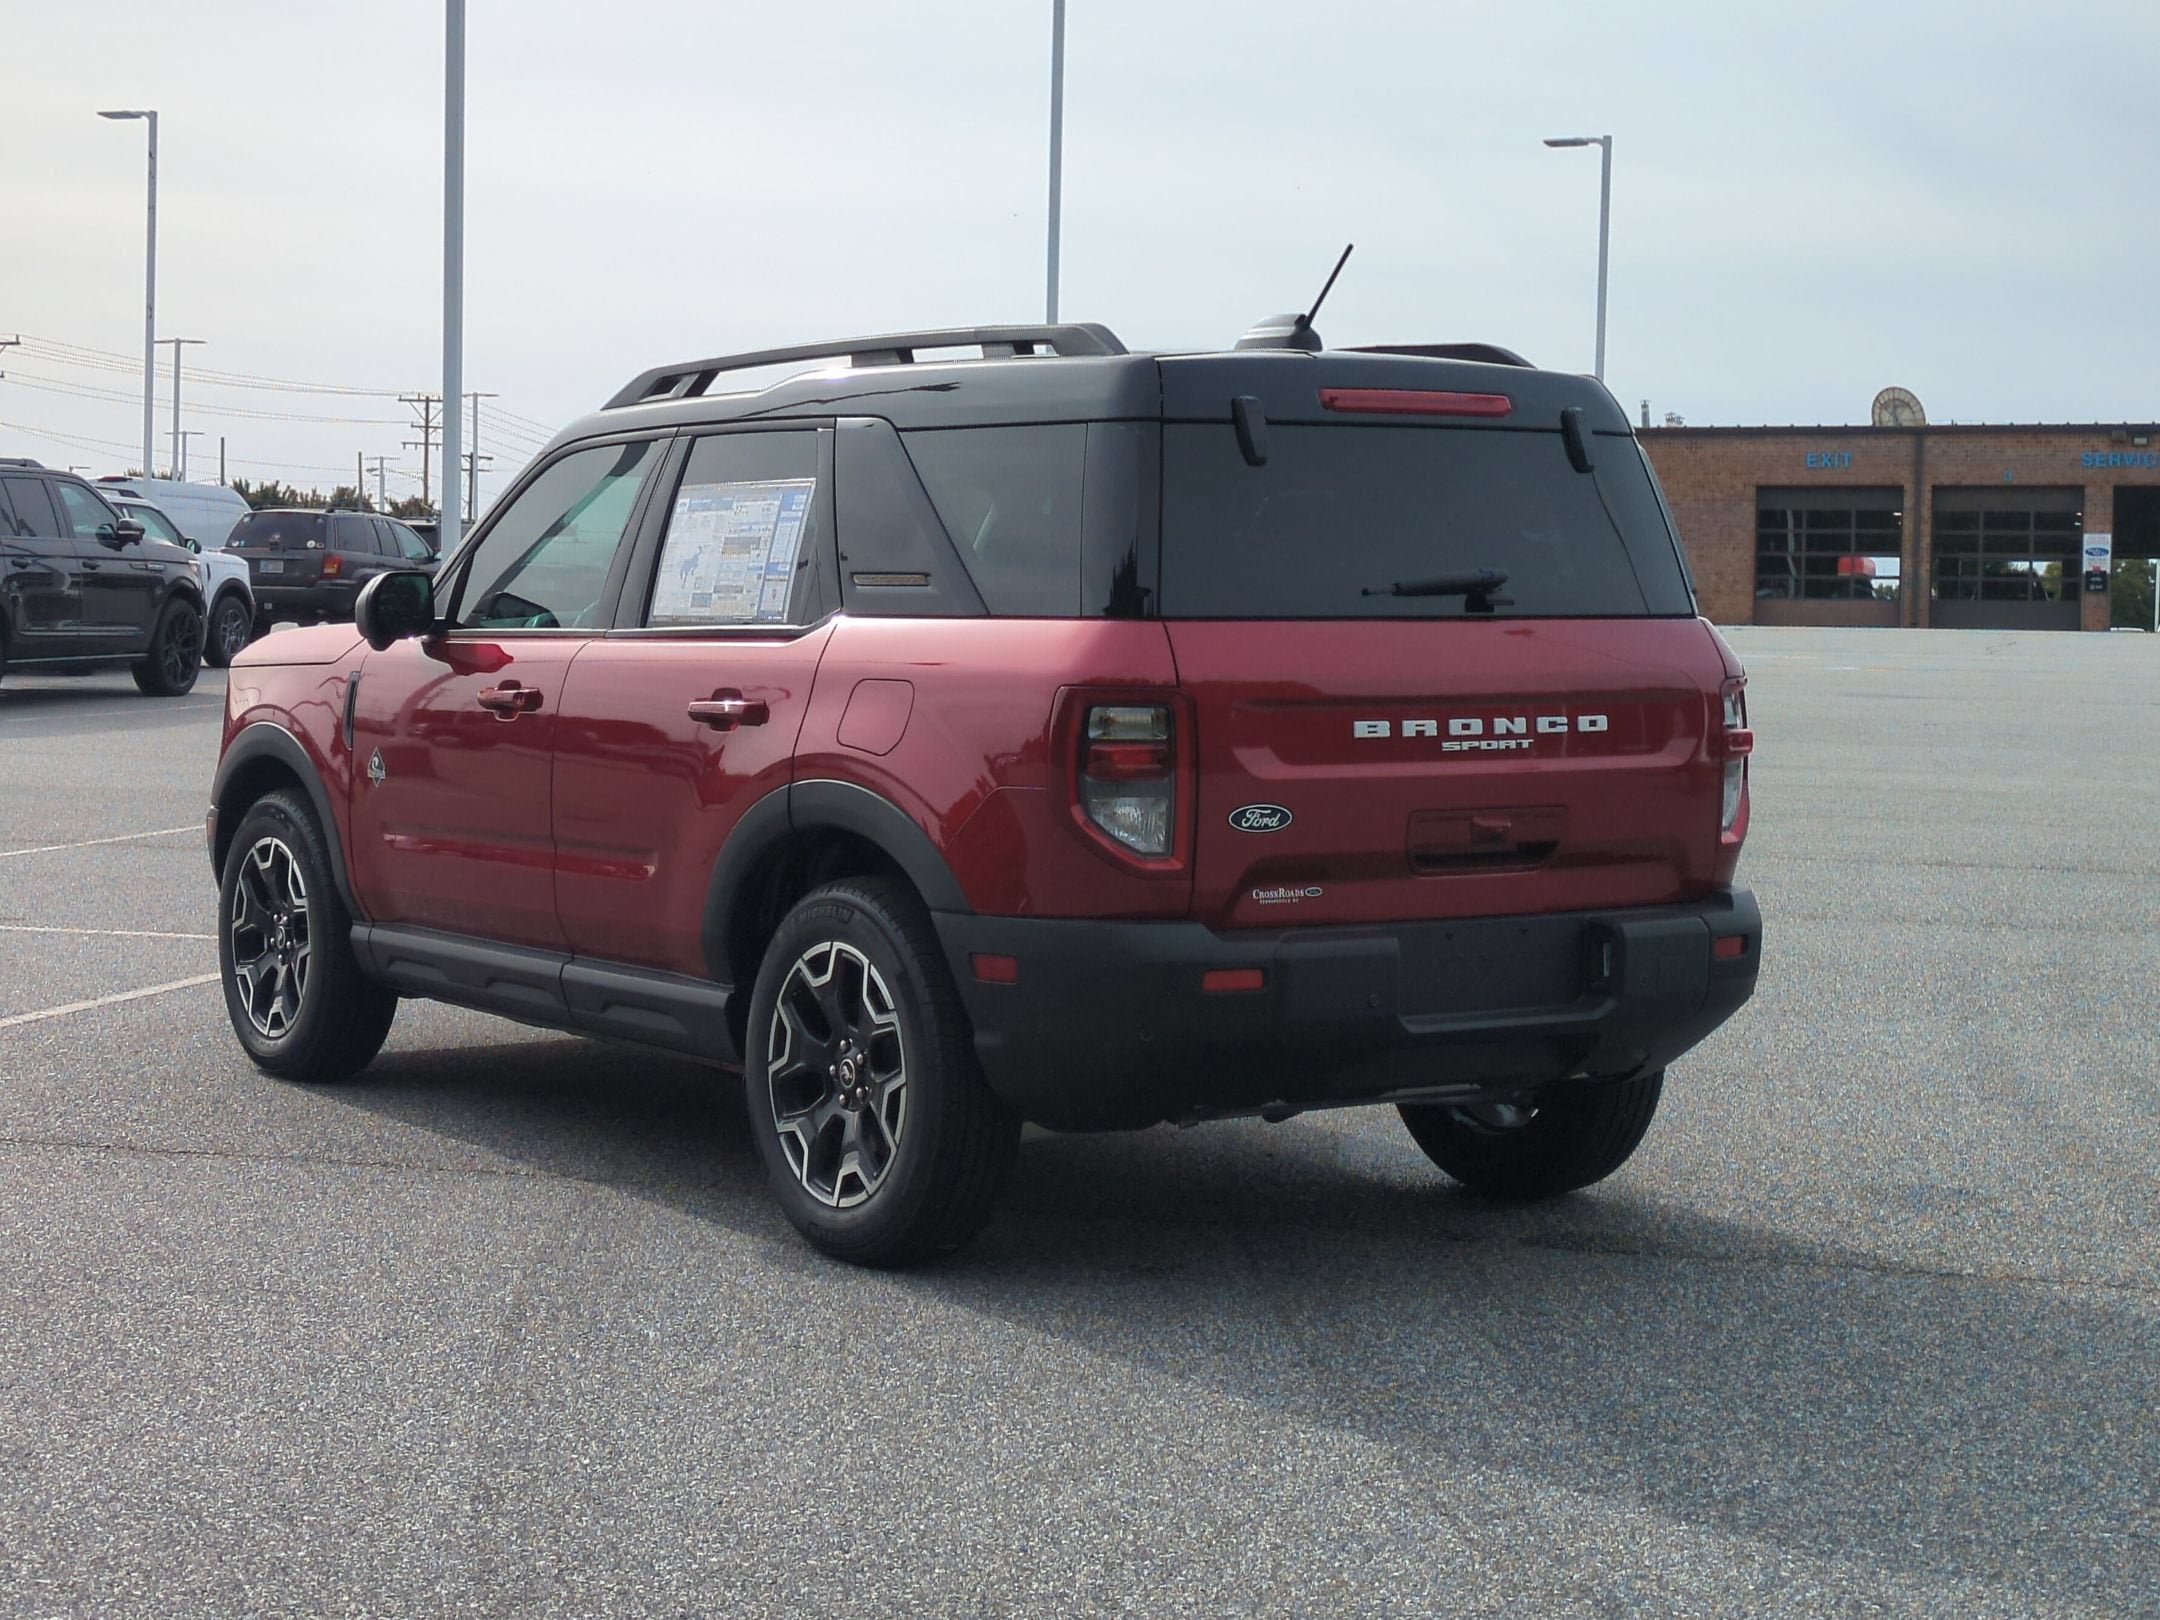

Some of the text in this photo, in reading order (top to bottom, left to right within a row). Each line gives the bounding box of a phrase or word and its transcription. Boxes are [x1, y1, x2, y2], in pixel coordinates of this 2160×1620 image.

[1806, 451, 1852, 468] EXIT
[2081, 452, 2160, 468] SERVIC
[1353, 715, 1608, 738] BRONCO
[1442, 739, 1534, 751] SPORT
[1241, 808, 1280, 827] Ford
